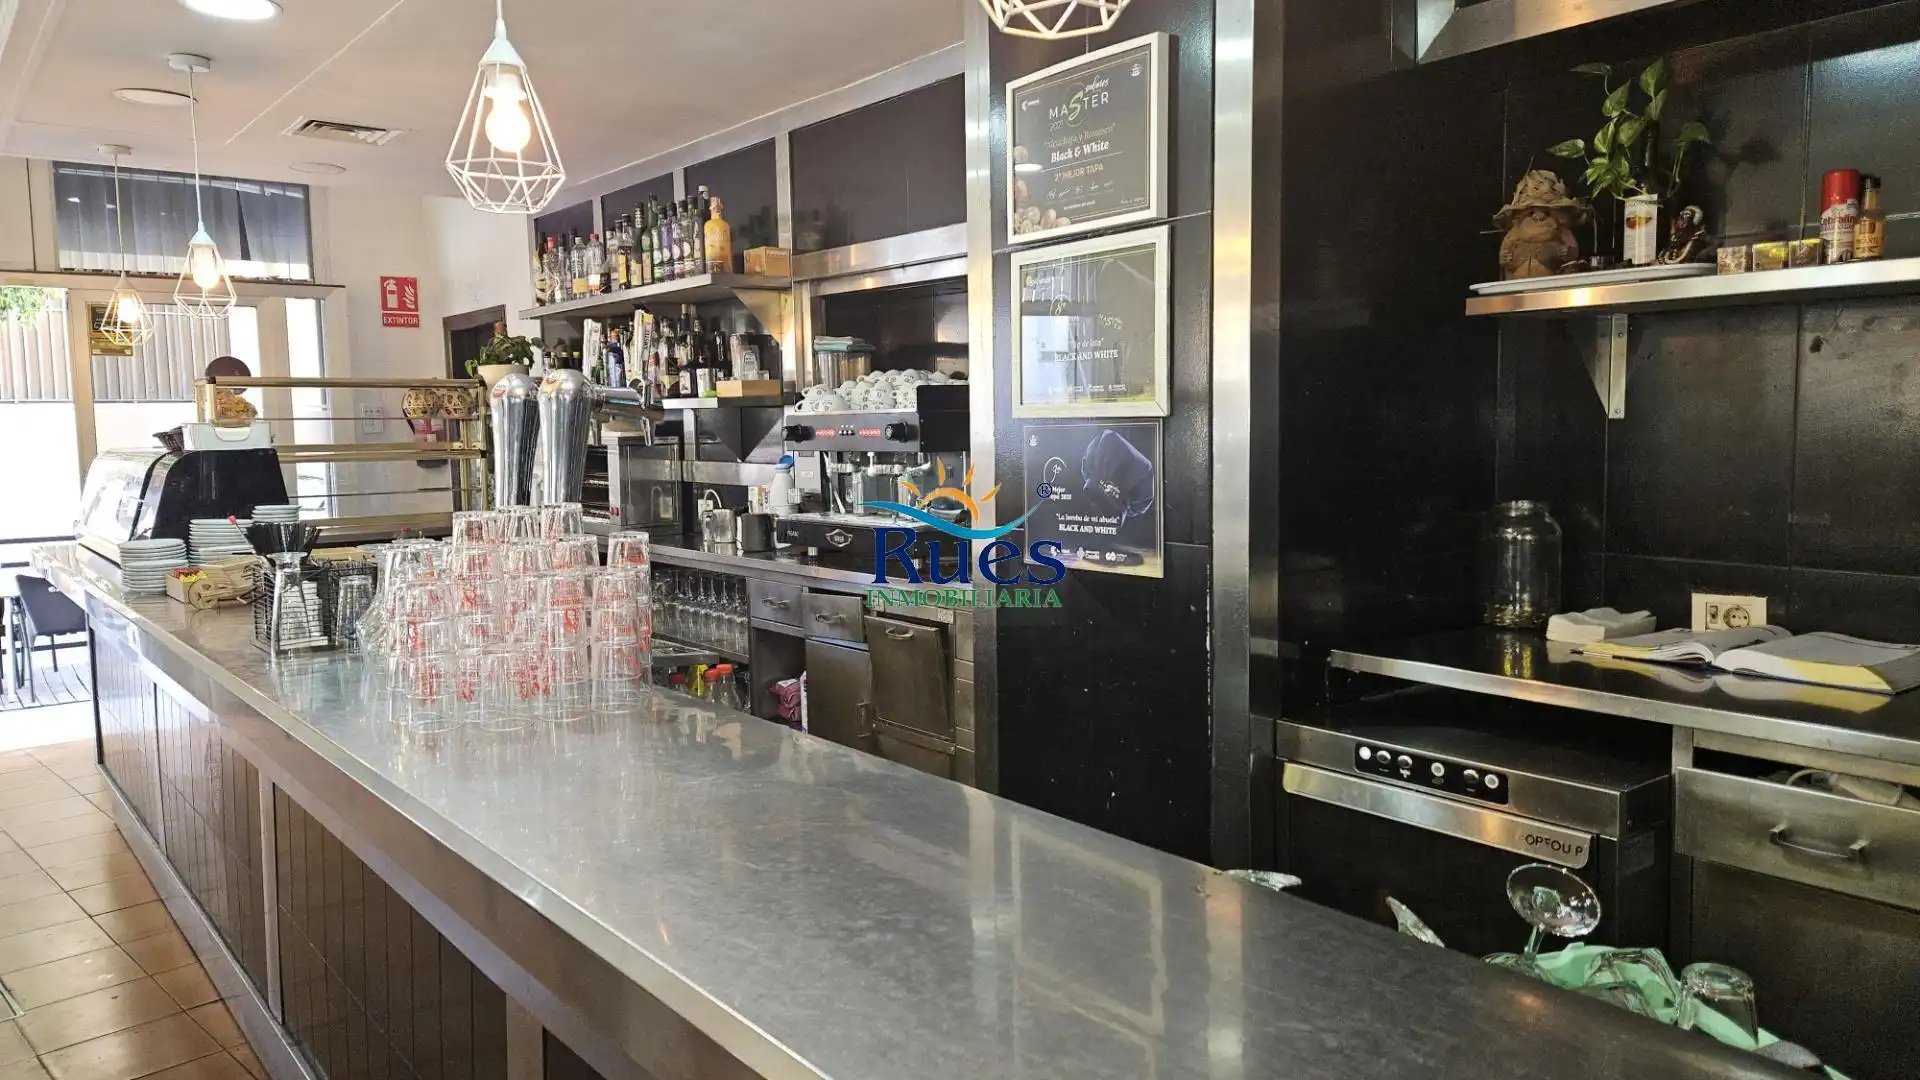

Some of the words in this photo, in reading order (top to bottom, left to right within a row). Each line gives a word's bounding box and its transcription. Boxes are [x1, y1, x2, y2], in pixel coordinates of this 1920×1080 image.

[1049, 90, 1109, 121] MASTER
[1051, 148, 1073, 163] Black
[1074, 146, 1082, 157] &
[1083, 140, 1109, 156] White
[383, 316, 418, 325] EXTINTOR
[1077, 351, 1093, 360] AND
[1094, 350, 1119, 359] WHITE
[1059, 523, 1079, 532] BLACK
[1080, 525, 1094, 533] AND
[1094, 526, 1117, 535] WHITE
